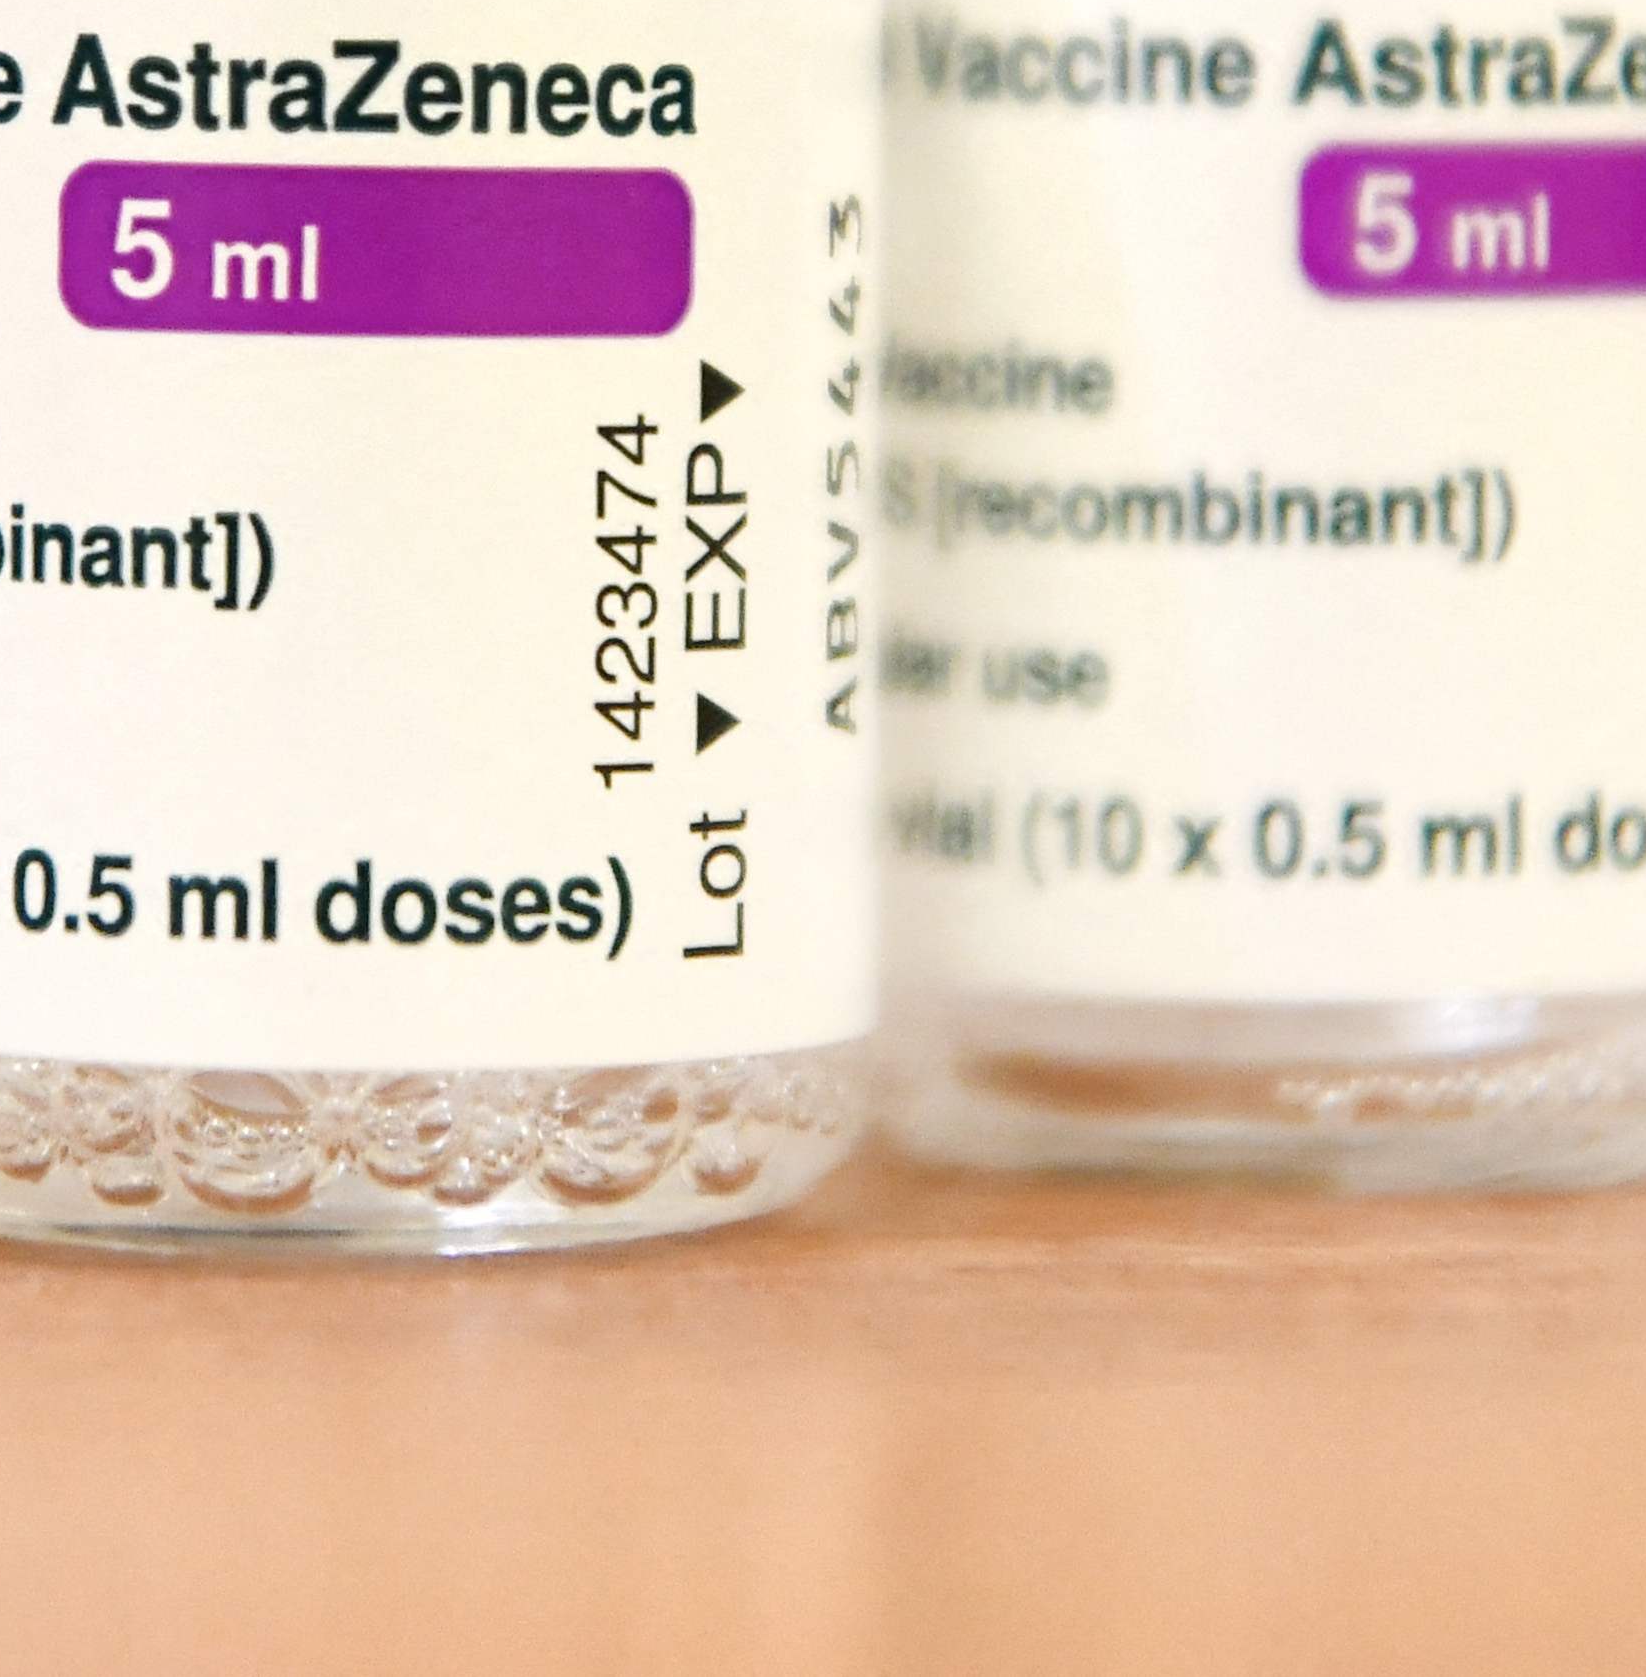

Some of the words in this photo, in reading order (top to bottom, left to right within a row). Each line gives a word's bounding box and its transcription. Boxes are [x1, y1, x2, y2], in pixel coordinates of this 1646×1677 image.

[51, 32, 698, 138] AstraZeneca
[913, 12, 1258, 108] Vaccine
[110, 197, 175, 301] 5
[211, 224, 320, 302] ml
[1352, 170, 1419, 277] 5
[1448, 191, 1551, 272] ml
[824, 194, 864, 735] ABV5443
[684, 442, 748, 652] EXP
[593, 414, 658, 790] 1423474
[981, 647, 1109, 709] use
[683, 809, 748, 960] Lot
[1020, 791, 1147, 888] (10
[1174, 816, 1221, 877] x
[1251, 797, 1388, 882] 0.5
[1417, 792, 1525, 877] ml
[12, 847, 136, 939] 0.5
[167, 857, 279, 943] ml
[314, 856, 634, 962] doses)
